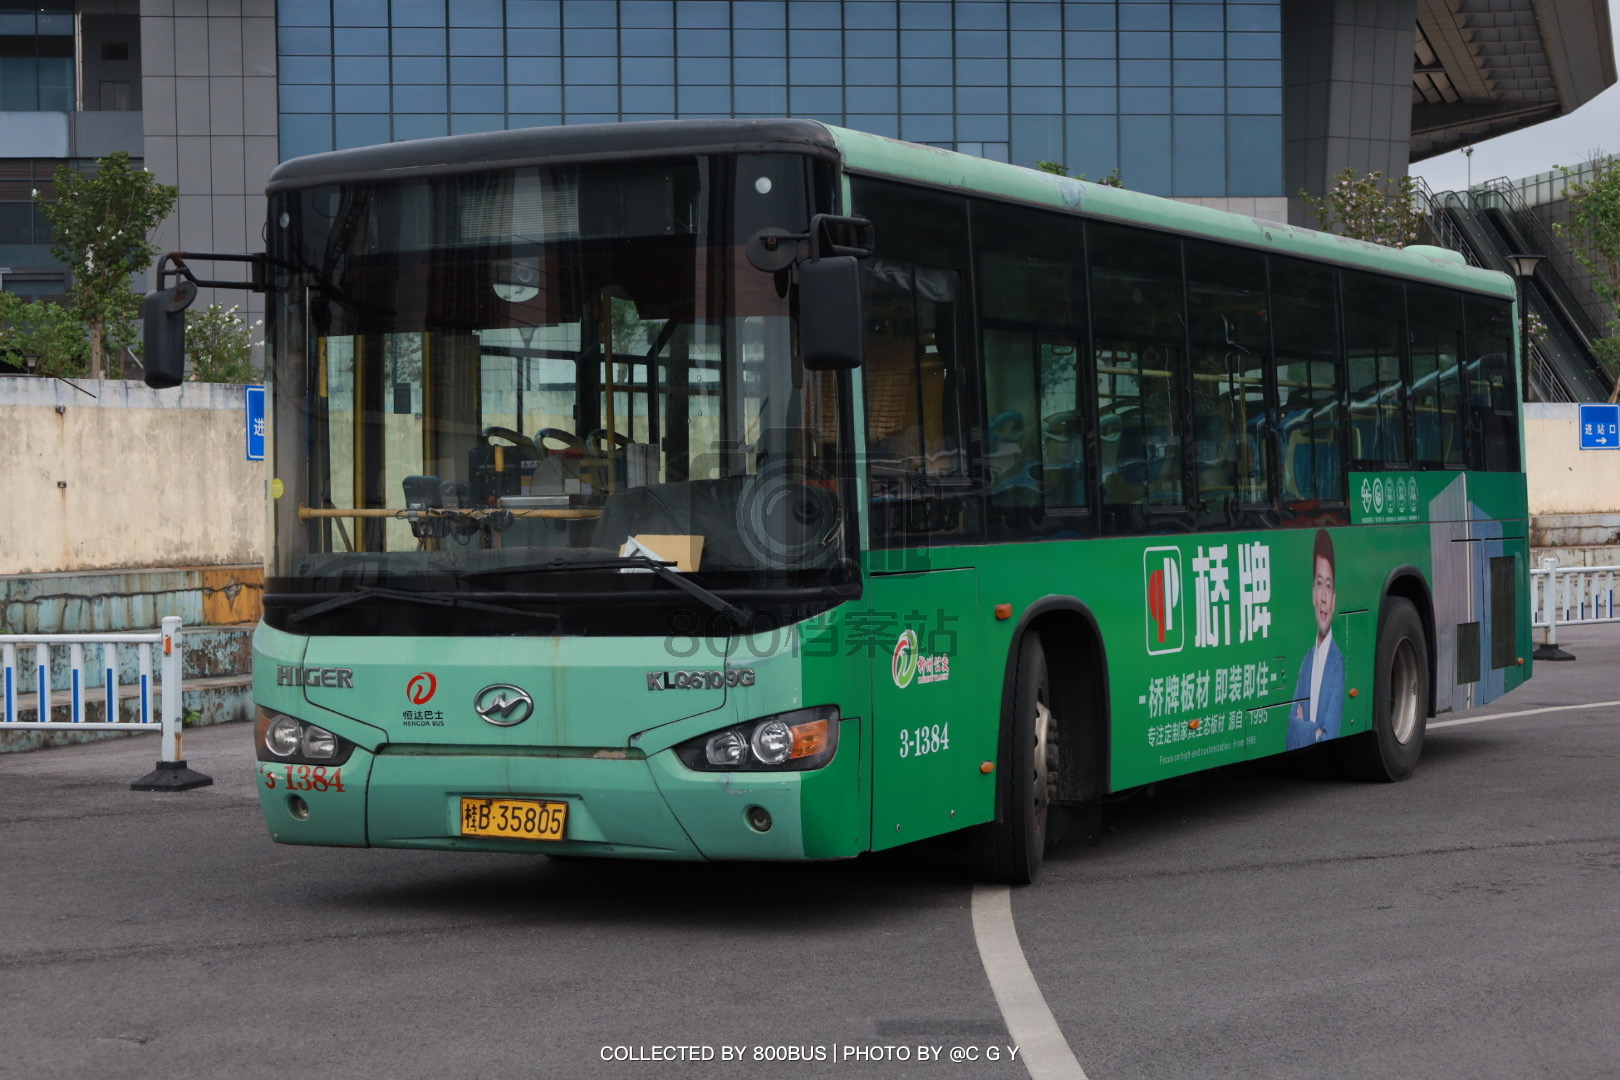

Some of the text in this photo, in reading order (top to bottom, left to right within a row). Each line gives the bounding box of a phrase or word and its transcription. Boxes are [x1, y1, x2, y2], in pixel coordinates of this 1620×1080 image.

[1585, 423, 1615, 436] 进站口
[1192, 541, 1271, 648] 桥牌
[276, 664, 354, 689] HIGER
[646, 668, 756, 691] KLQ6109G
[402, 710, 444, 720] 恒达巴士
[899, 721, 950, 758] 3-1384
